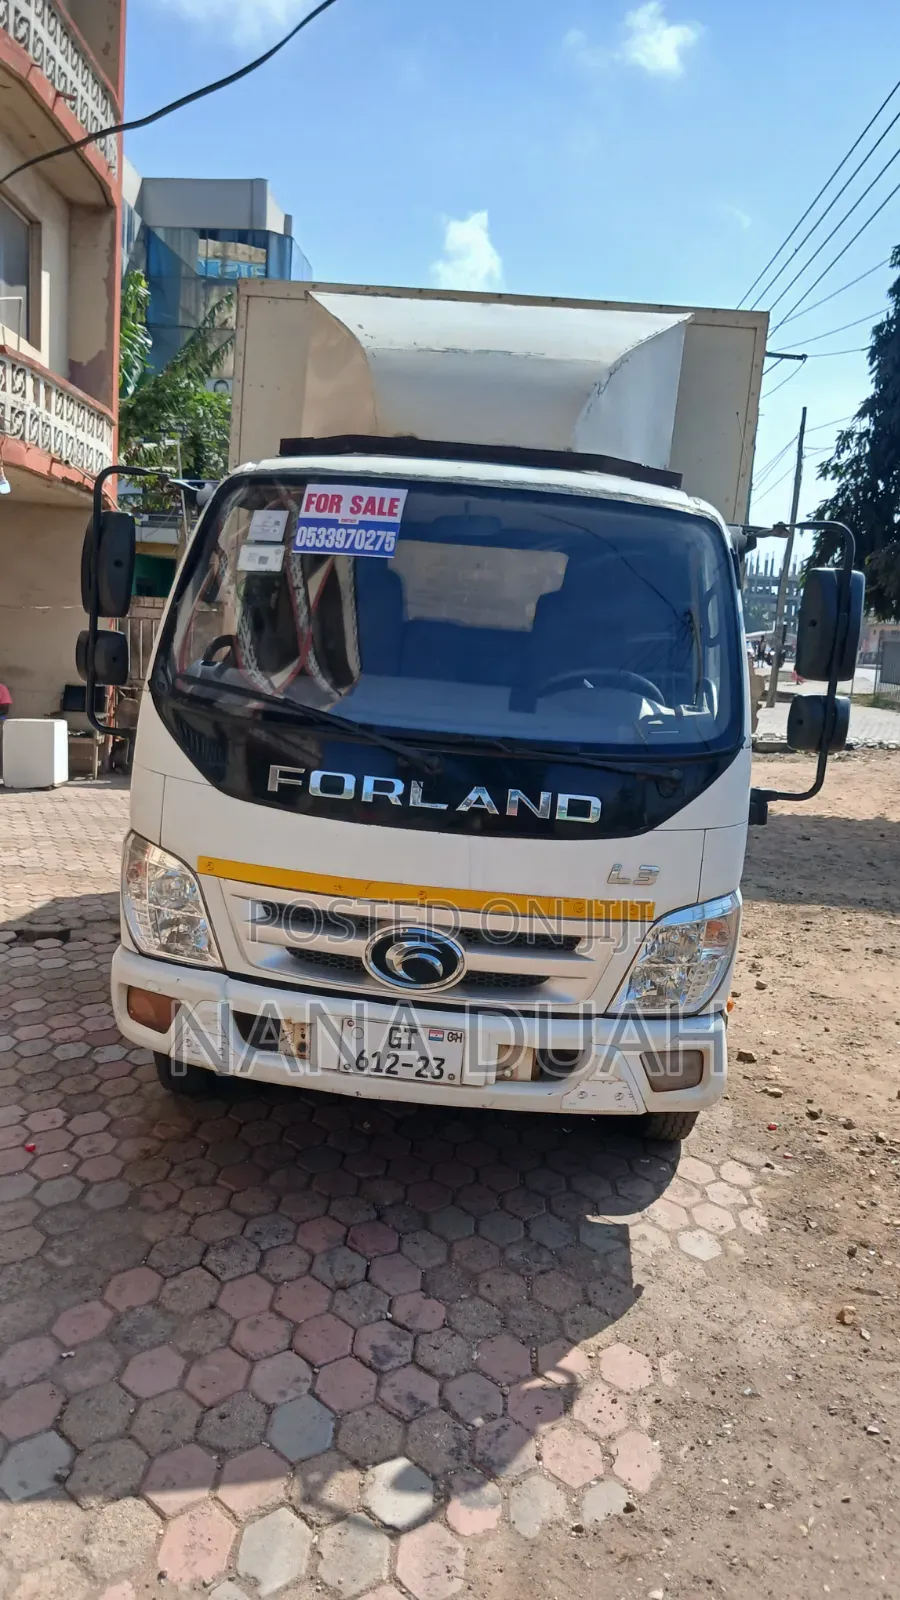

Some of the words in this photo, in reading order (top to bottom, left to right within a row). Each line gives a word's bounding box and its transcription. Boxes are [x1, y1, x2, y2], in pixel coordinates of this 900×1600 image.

[304, 494, 343, 513] FOR
[350, 496, 400, 517] SALE
[295, 526, 396, 552] 0533970275
[267, 764, 602, 824] FORLAND
[388, 1026, 418, 1050] GT
[355, 1049, 445, 1079] 612-23
